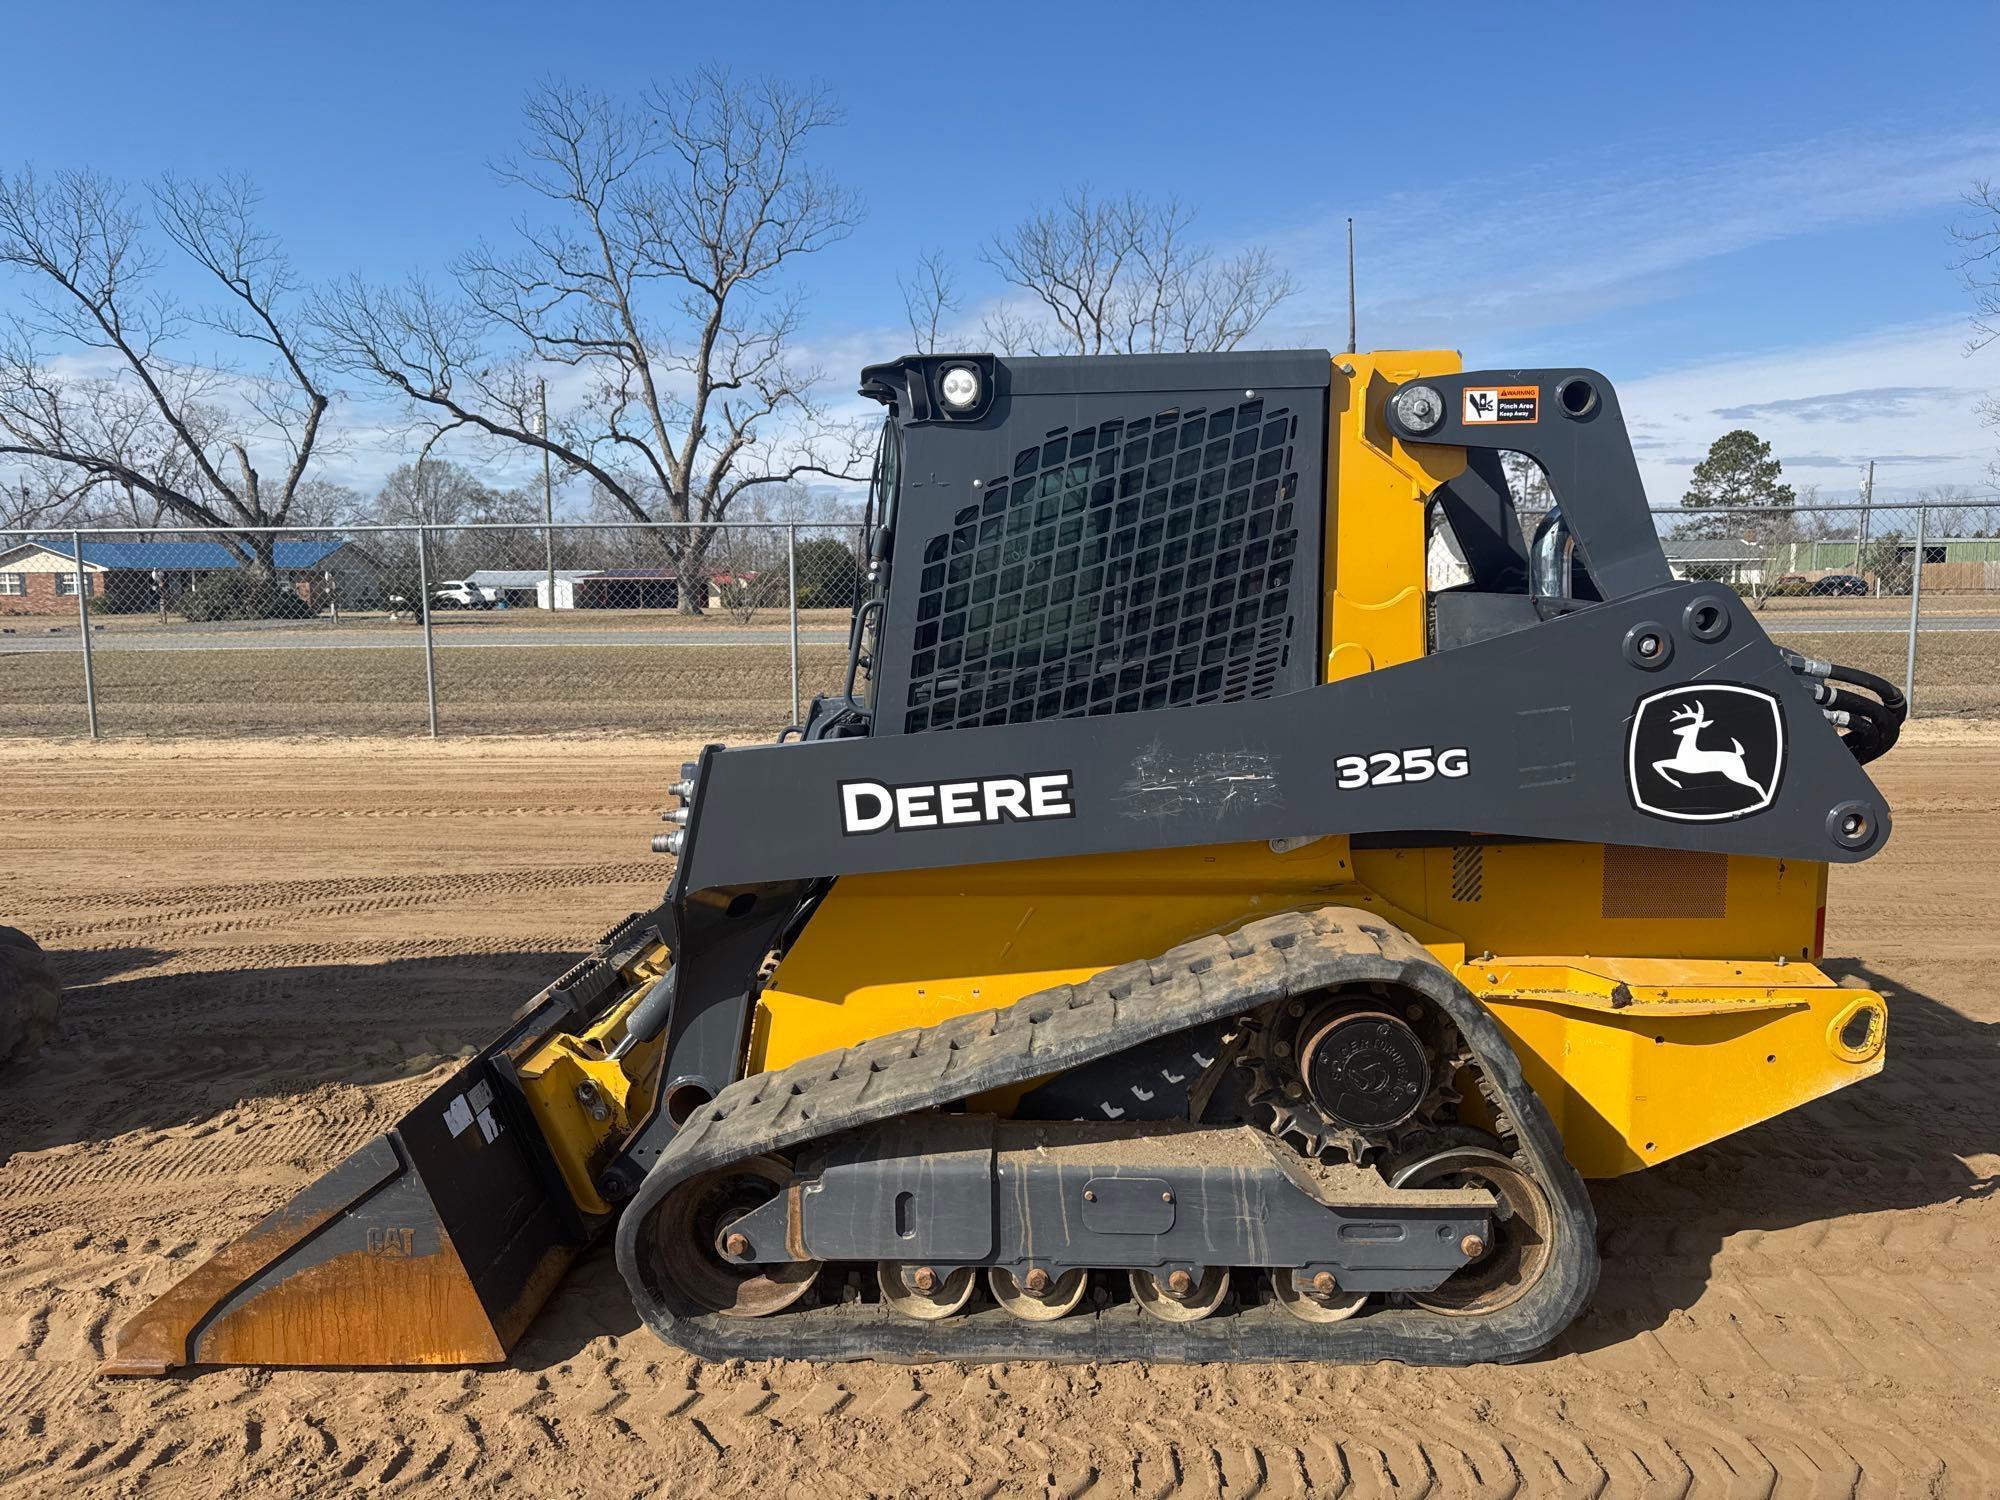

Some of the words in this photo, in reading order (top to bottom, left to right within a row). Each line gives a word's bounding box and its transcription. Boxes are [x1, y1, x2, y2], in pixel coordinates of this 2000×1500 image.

[1499, 402, 1518, 410] Pinch
[1335, 747, 1470, 789] 325G
[841, 773, 1072, 833] DEERE
[366, 1227, 416, 1257] CAT
